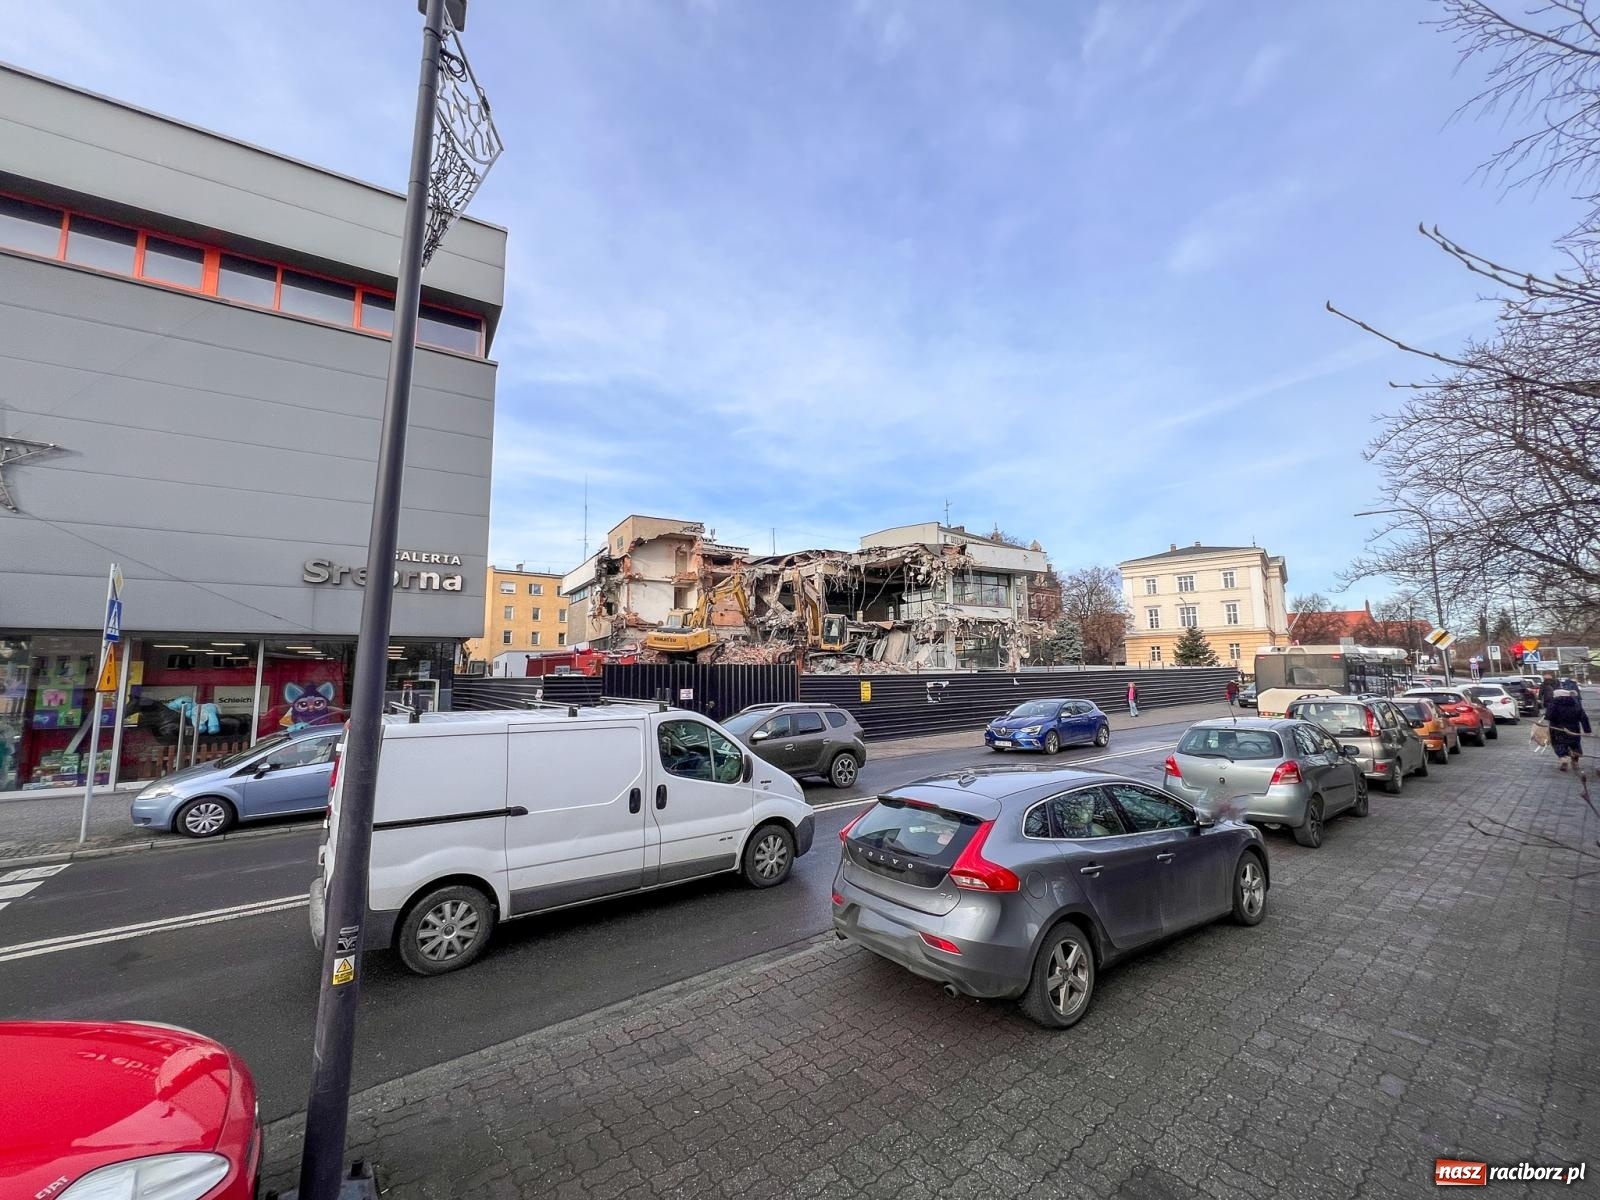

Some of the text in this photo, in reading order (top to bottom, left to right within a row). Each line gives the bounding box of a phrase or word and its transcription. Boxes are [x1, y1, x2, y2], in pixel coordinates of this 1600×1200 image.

[303, 559, 463, 592] Srerna
[218, 696, 252, 704] Schleich
[858, 847, 914, 869] VOLVO
[33, 1175, 69, 1199] FIAT
